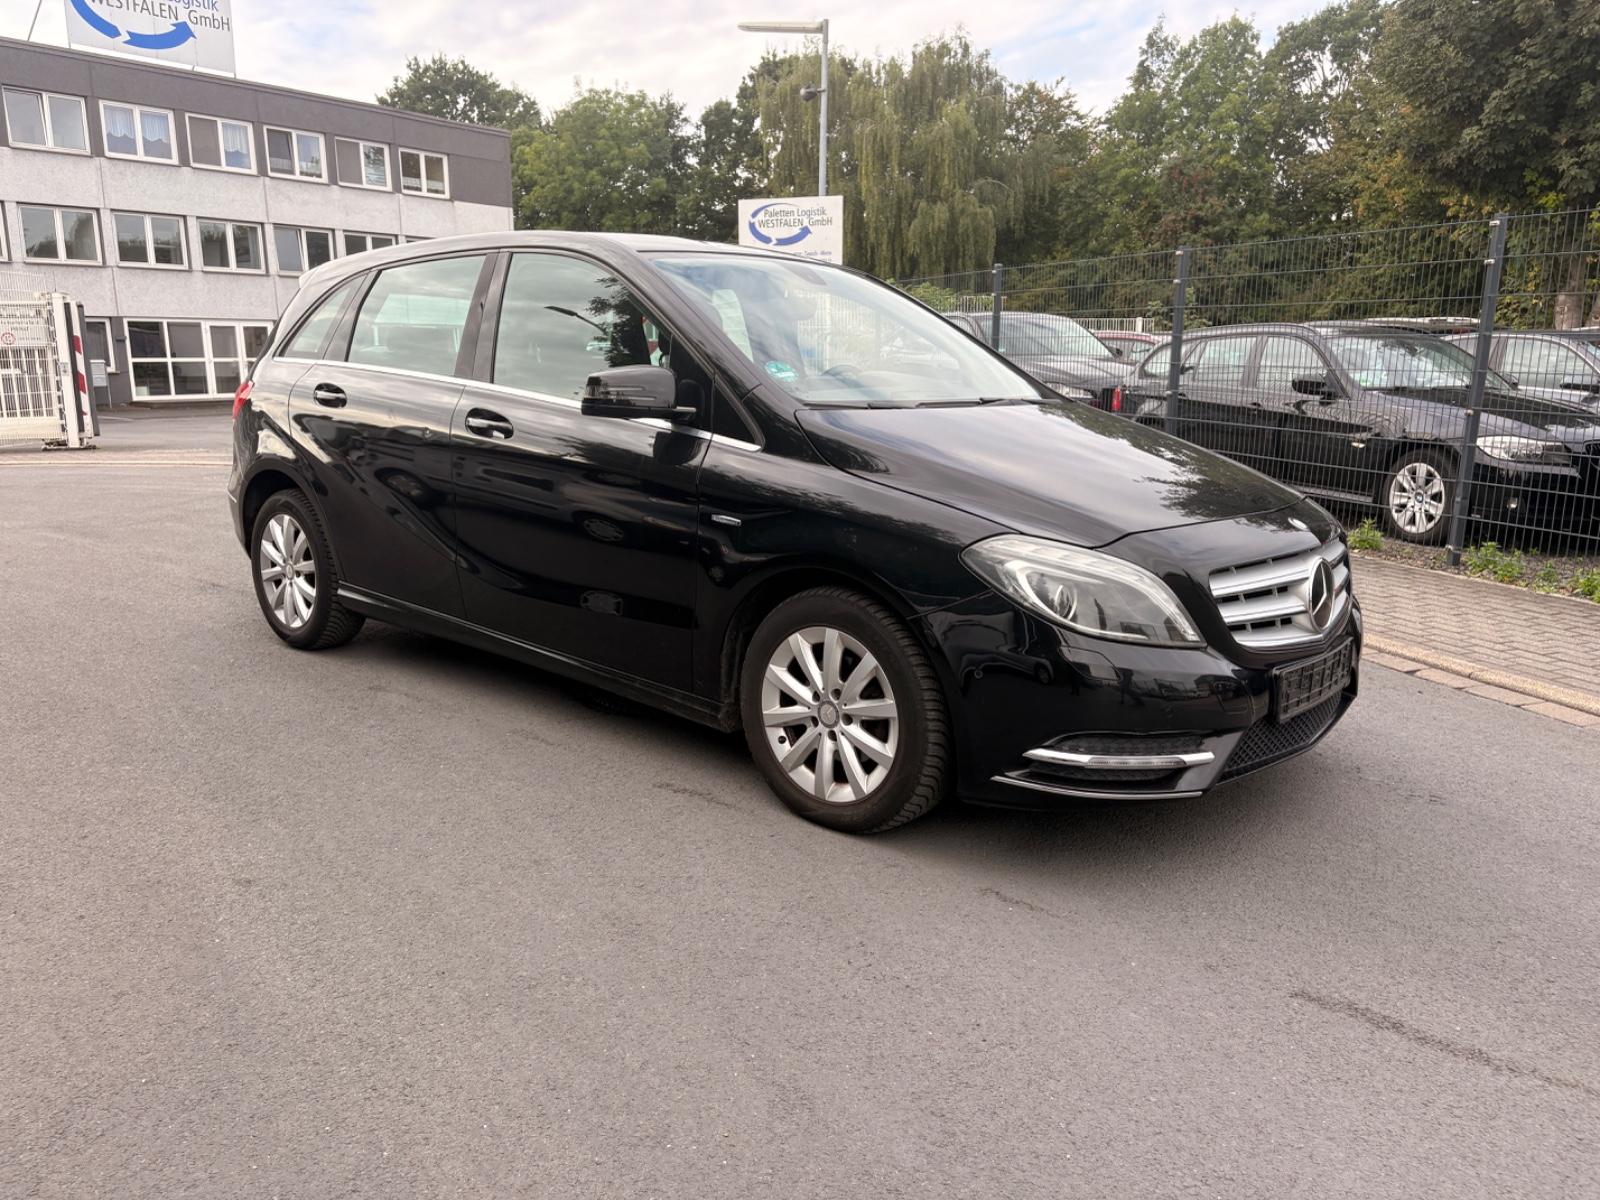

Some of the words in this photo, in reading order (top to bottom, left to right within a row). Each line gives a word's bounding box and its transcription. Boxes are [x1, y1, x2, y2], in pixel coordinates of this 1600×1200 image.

[168, 0, 219, 12] gistik
[92, 0, 178, 21] STFALEN
[188, 10, 231, 32] GmbH
[764, 208, 795, 218] Paletten
[796, 207, 827, 219] Logistik
[758, 218, 804, 229] WESTFALEN
[808, 216, 833, 226] GmbH
